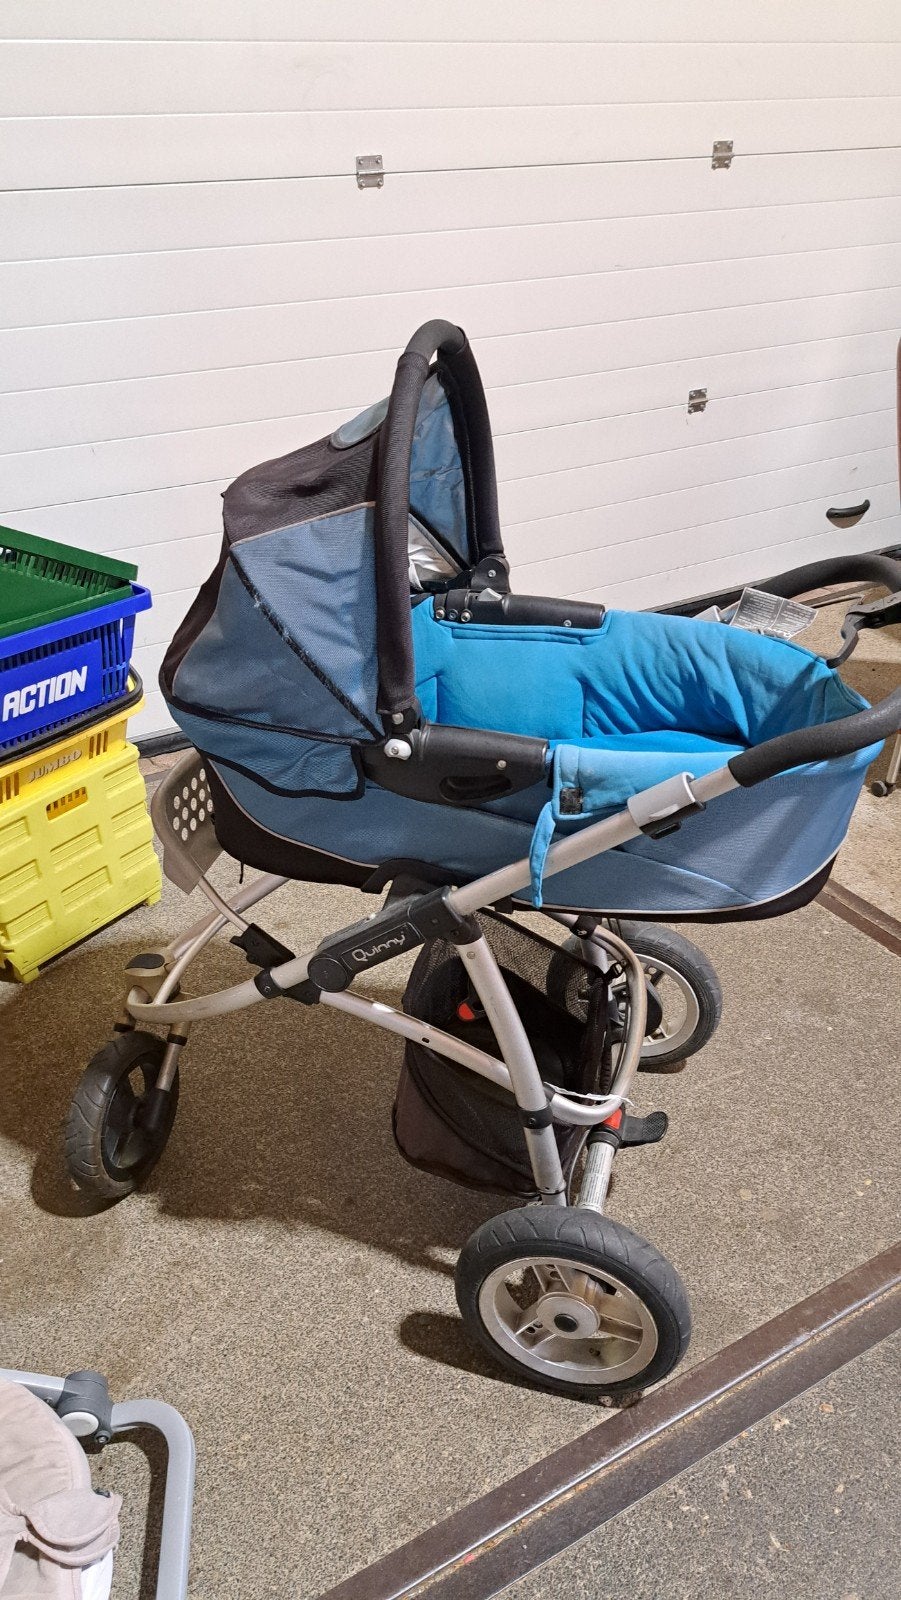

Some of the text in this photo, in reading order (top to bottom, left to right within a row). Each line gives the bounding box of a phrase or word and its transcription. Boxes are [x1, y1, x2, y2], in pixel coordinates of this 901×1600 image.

[2, 665, 88, 722] ACTION
[27, 749, 82, 783] JUMBO
[351, 933, 406, 962] Quinny
